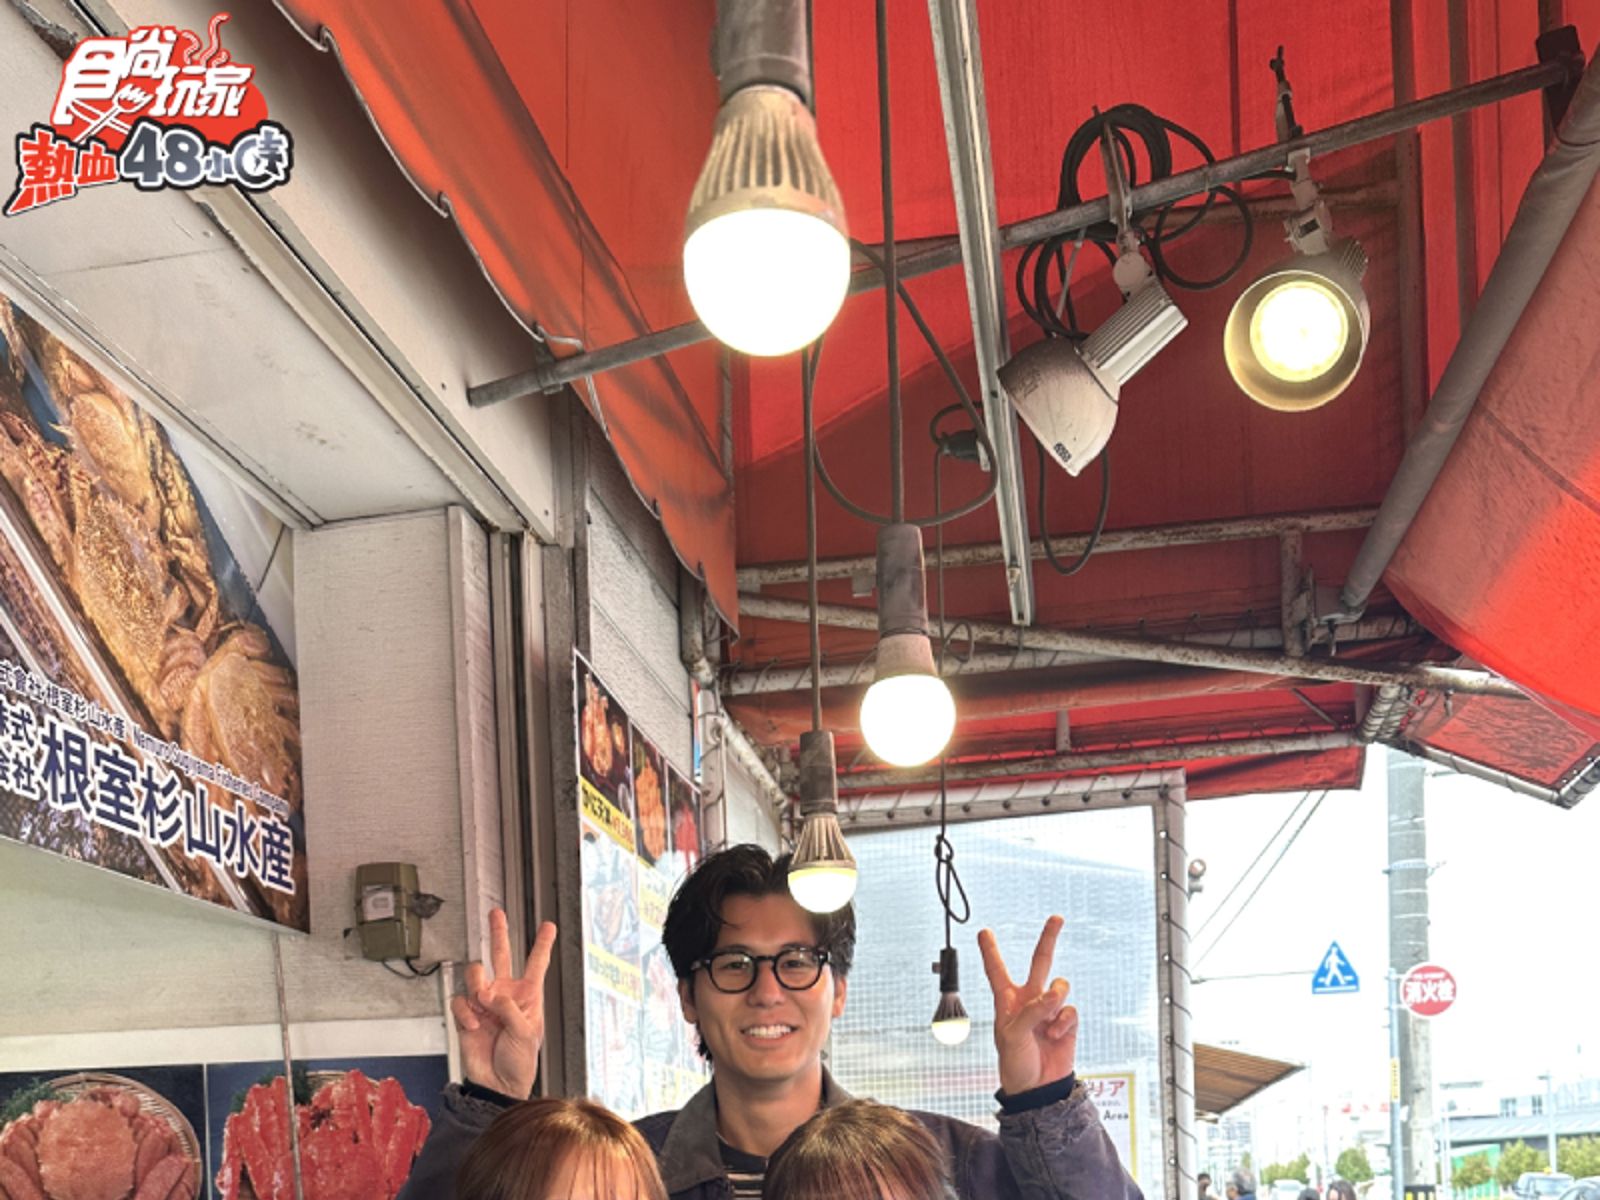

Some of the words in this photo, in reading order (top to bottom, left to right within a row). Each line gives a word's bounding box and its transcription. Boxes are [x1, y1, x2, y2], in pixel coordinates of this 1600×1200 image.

[41, 721, 294, 890] 根室杉山水産
